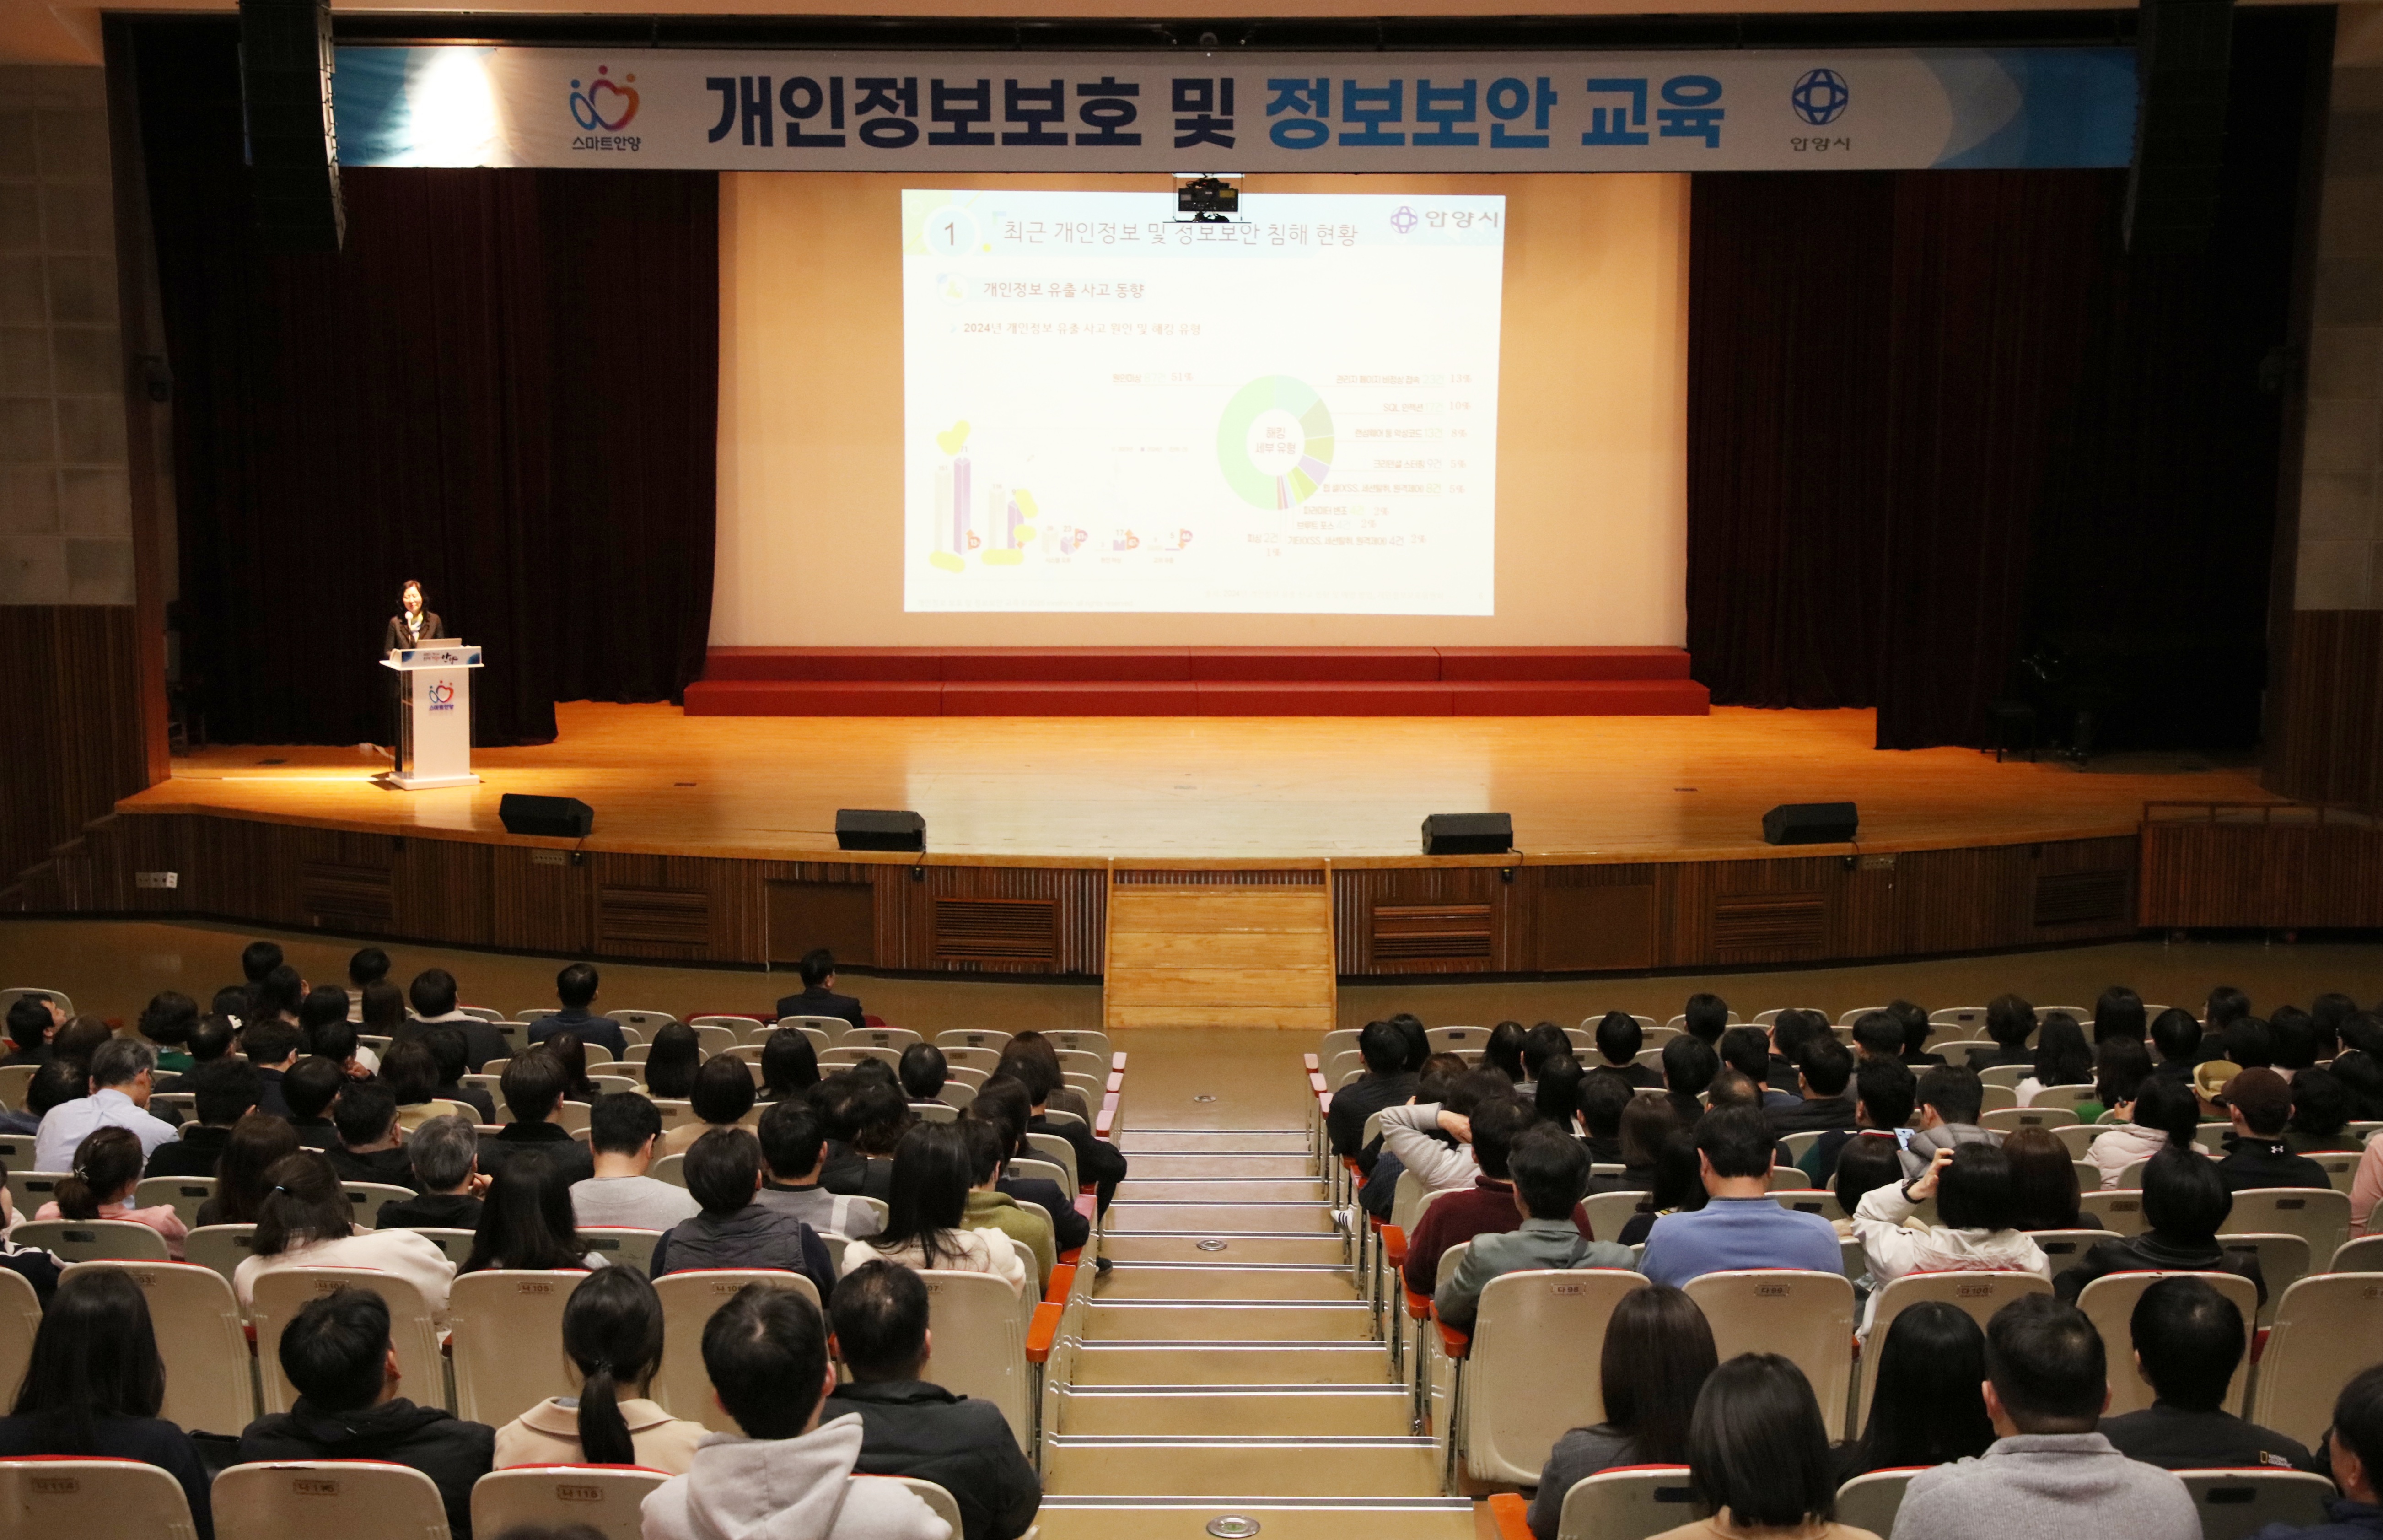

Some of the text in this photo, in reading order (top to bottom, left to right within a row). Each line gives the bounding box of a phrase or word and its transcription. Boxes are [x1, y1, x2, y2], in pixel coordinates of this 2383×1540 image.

[706, 75, 1724, 149] 개인정보보호 및 정보보안 교육
[572, 137, 641, 151] 스마트안양
[1790, 137, 1851, 151] 안양시
[1425, 211, 1499, 229] 안양시
[944, 222, 954, 246] 1
[1004, 221, 1359, 247] 최근 개인정보 및 정보보안 침해 현황
[983, 282, 1145, 299] 개인정보 유출 사고 동향
[963, 323, 1202, 336] 2024년 개인정보 유출 사고 원인 및 해킹 유형
[1171, 372, 1194, 382] 51%
[1450, 374, 1472, 383] 13%
[1383, 403, 1400, 412] SQL
[1449, 401, 1471, 410] 10%
[1266, 426, 1286, 439] 해킹
[1451, 429, 1468, 438] 8%
[1255, 442, 1296, 455] 세부 유형
[1427, 459, 1442, 469] 9건
[1450, 459, 1467, 468] 5%
[1425, 483, 1442, 493] 8건
[1449, 485, 1466, 494] 5%
[1373, 506, 1390, 516] 2%
[1361, 519, 1377, 528] 2%
[1389, 537, 1404, 546] 4건
[1410, 534, 1427, 544] 2%
[1266, 548, 1281, 557] 1%
